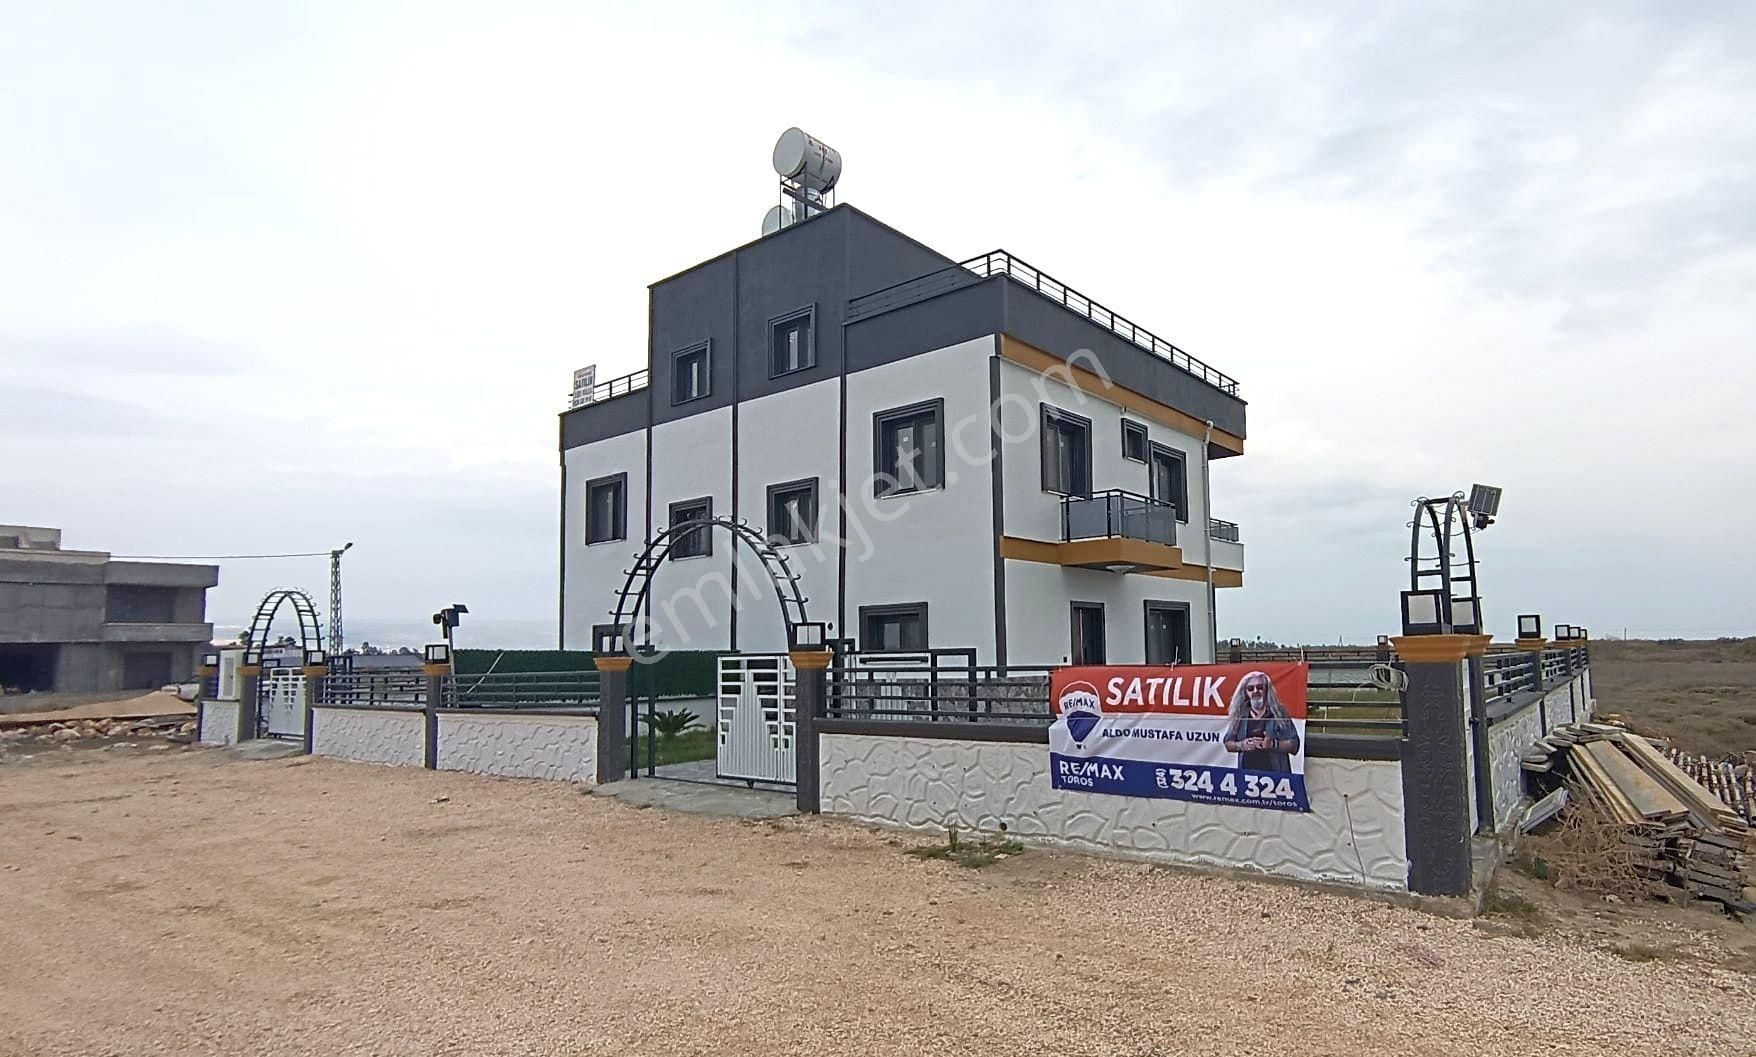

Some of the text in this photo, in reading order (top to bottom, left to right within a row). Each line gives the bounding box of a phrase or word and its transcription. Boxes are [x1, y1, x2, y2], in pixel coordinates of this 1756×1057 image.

[1105, 676, 1227, 708] SATILIK
[1063, 697, 1095, 710] RE/MAX
[1102, 728, 1220, 743] ALDO MUSTAFA UZUN
[1059, 760, 1125, 781] RE/MAX
[1060, 775, 1094, 787] TOROS
[1169, 768, 1214, 793] 324
[1219, 772, 1238, 796] 4
[1244, 774, 1295, 800] 324
[1191, 793, 1298, 807] www.remax.com.tr/toros
